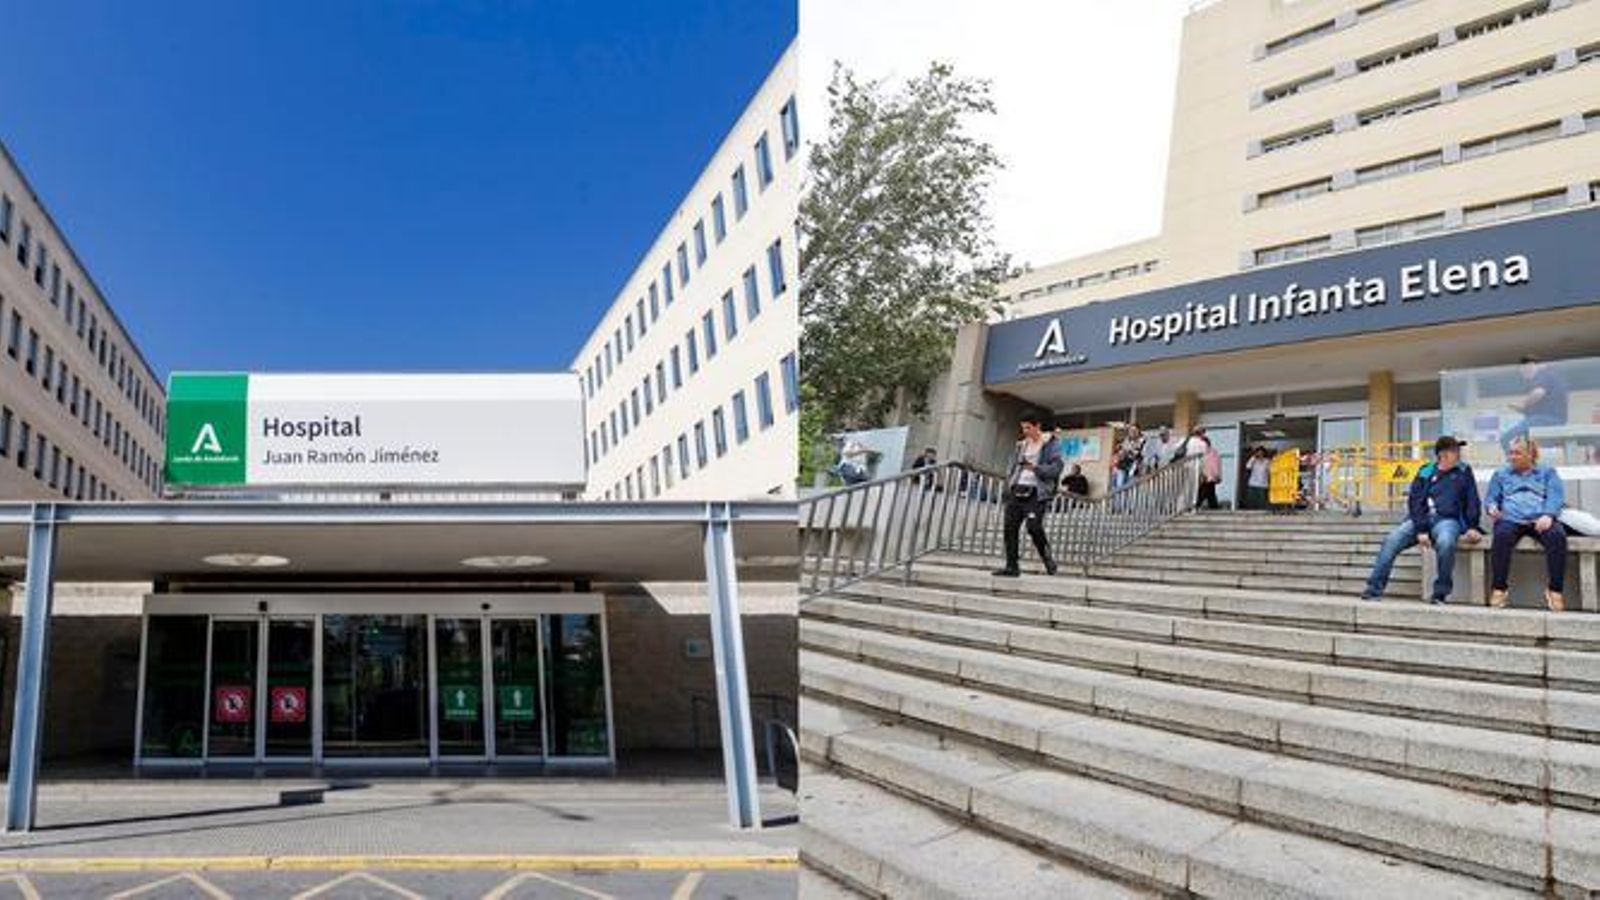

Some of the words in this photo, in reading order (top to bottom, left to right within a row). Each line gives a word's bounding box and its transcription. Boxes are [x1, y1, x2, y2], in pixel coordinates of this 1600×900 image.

[1107, 299, 1238, 346] Hospital
[1248, 275, 1387, 324] Infanta
[1400, 253, 1531, 301] Elena
[263, 415, 362, 441] Hospital
[263, 450, 303, 464] Juan
[307, 447, 366, 464] Ramón
[369, 446, 439, 464] Jiménez
